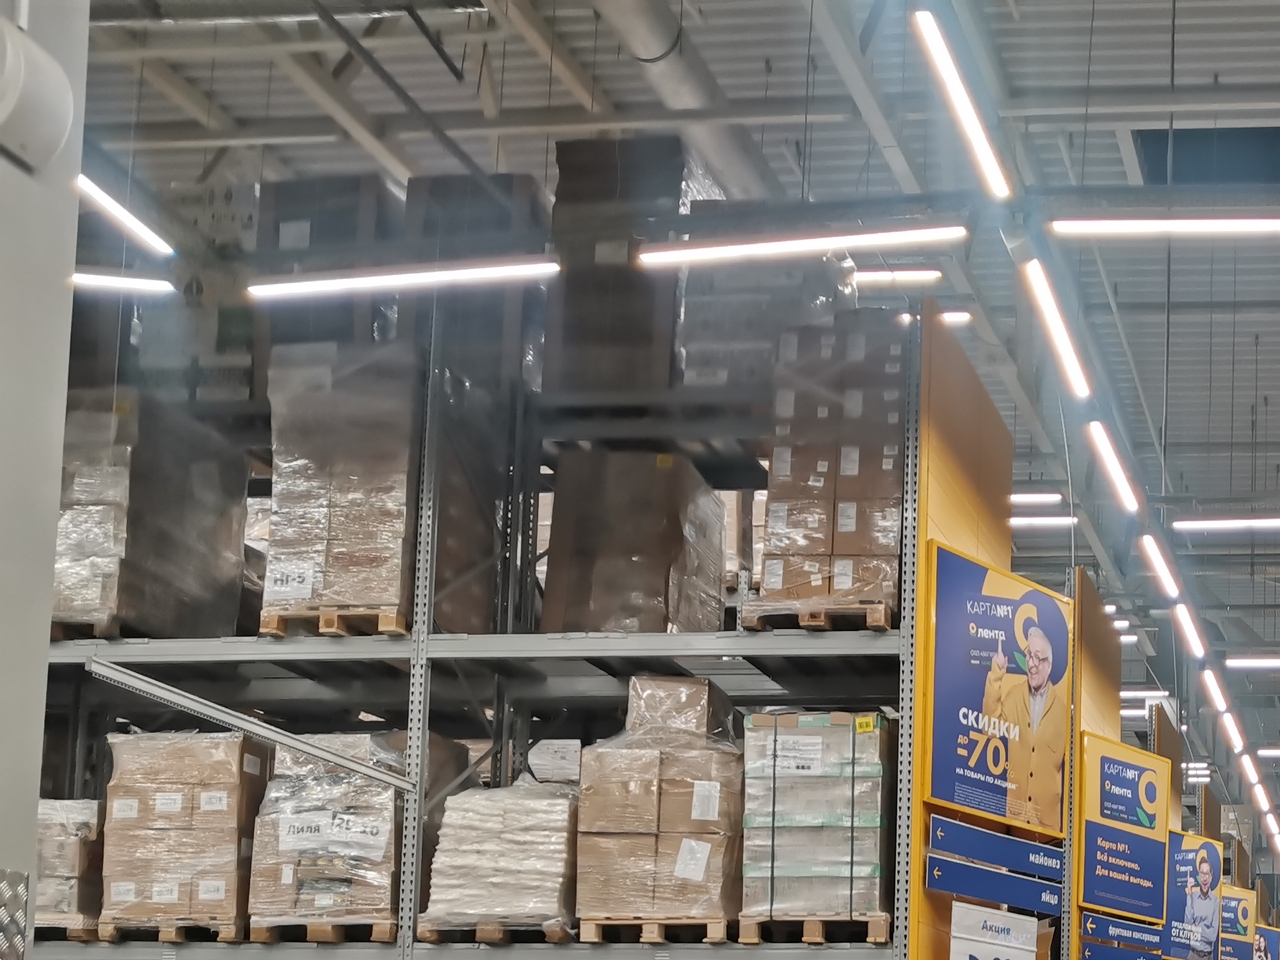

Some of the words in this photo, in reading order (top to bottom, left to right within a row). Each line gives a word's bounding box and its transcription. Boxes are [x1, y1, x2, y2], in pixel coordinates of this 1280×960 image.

[978, 627, 1006, 640] лента
[959, 707, 1019, 741] СКИДКИ
[958, 734, 968, 745] до
[956, 767, 964, 776] НА
[964, 769, 985, 782] ТОВАРЫ
[986, 776, 994, 784] ПО
[1097, 836, 1116, 850] Карта
[1029, 852, 1060, 869] майонез
[1096, 865, 1108, 876] Для
[1041, 890, 1058, 905] яйцо
[981, 920, 1011, 936] Акция
